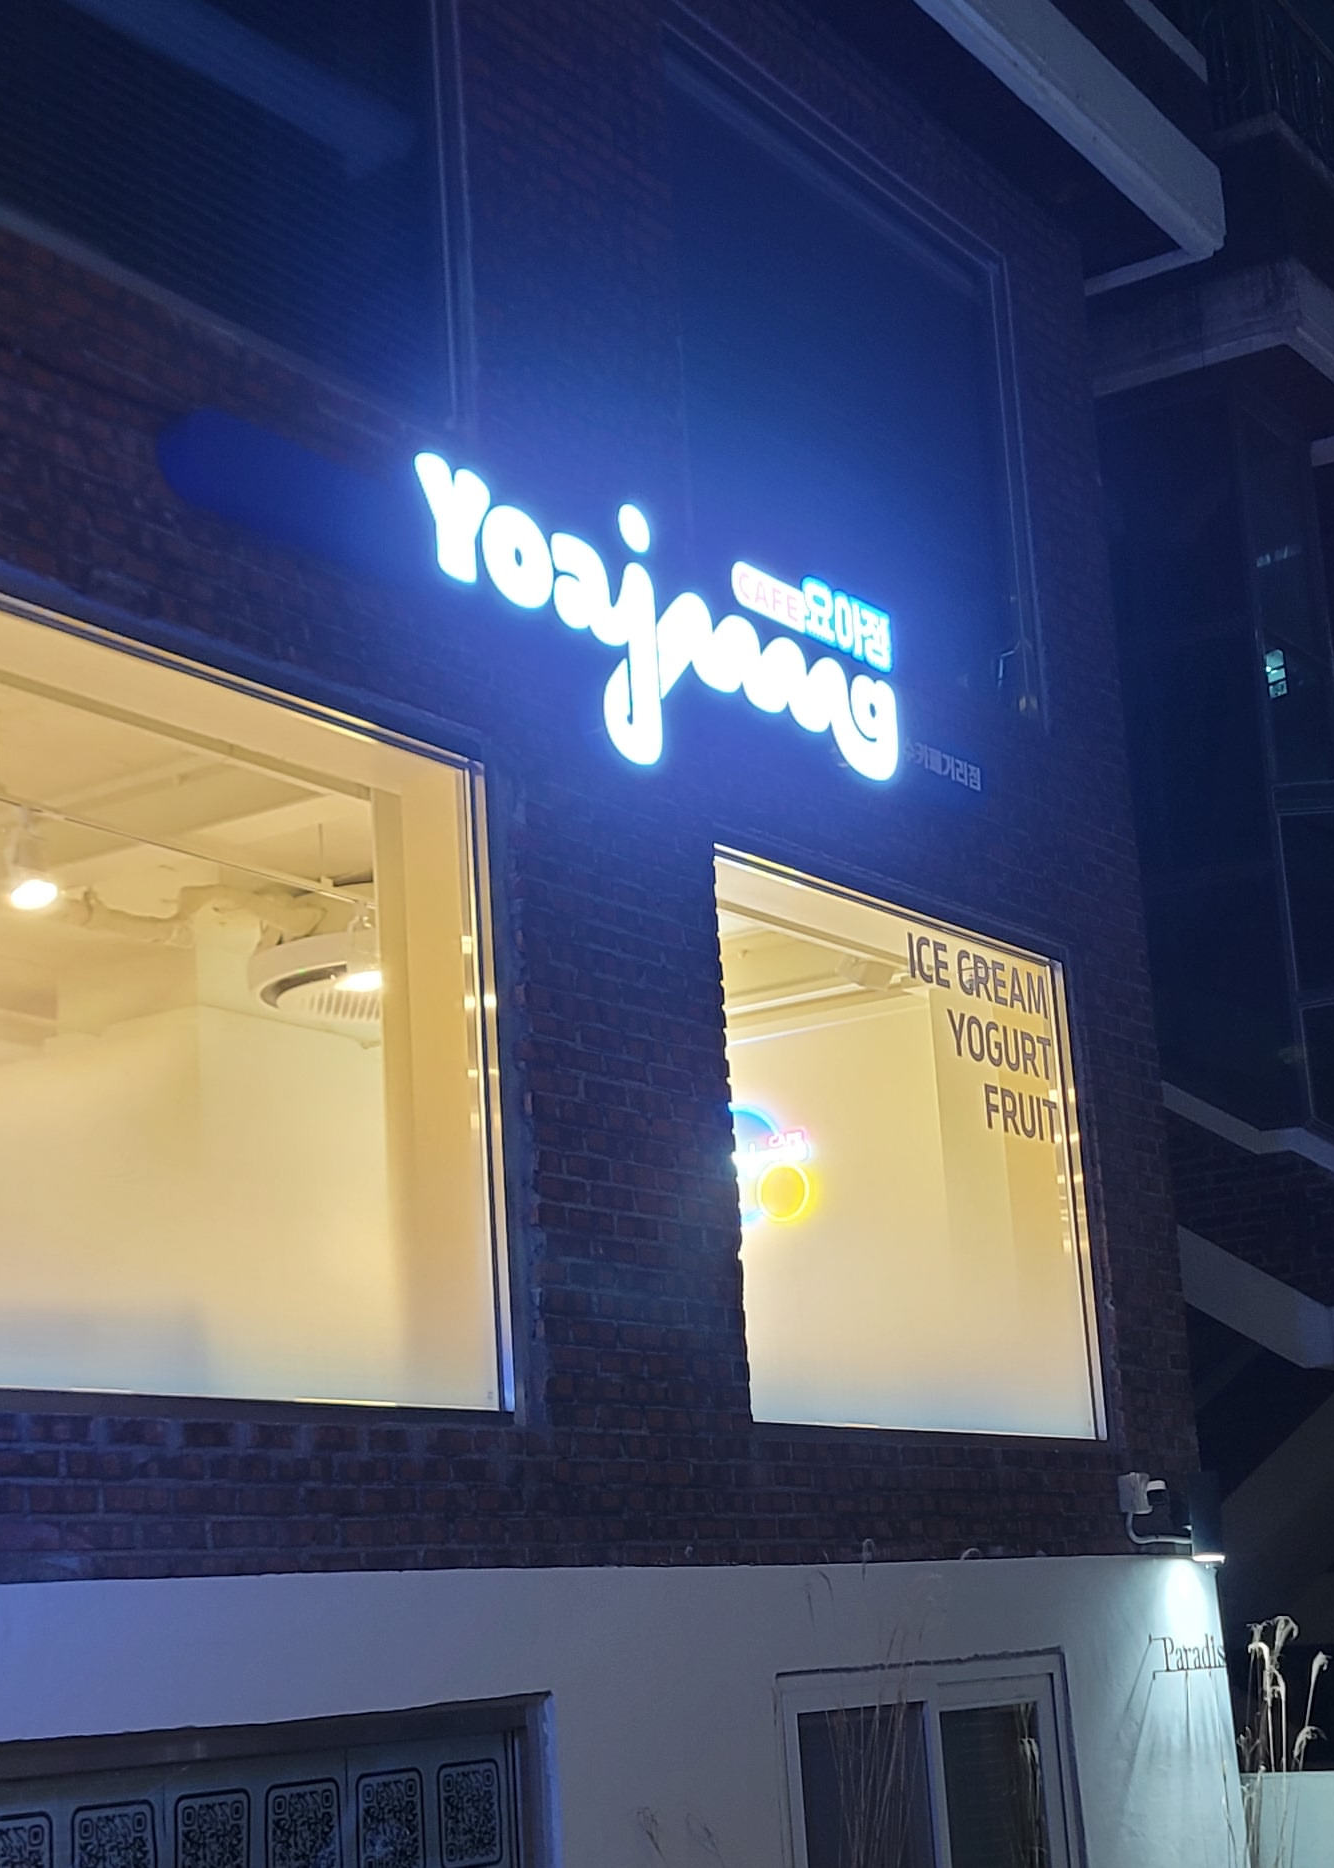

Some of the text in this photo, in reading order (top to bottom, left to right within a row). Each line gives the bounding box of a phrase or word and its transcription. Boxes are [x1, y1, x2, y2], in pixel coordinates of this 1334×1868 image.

[736, 567, 801, 626] CAFE
[907, 931, 1048, 1020] ICE CREAM
[946, 1008, 1052, 1081] YOGURT
[983, 1083, 1058, 1144] FRUIT
